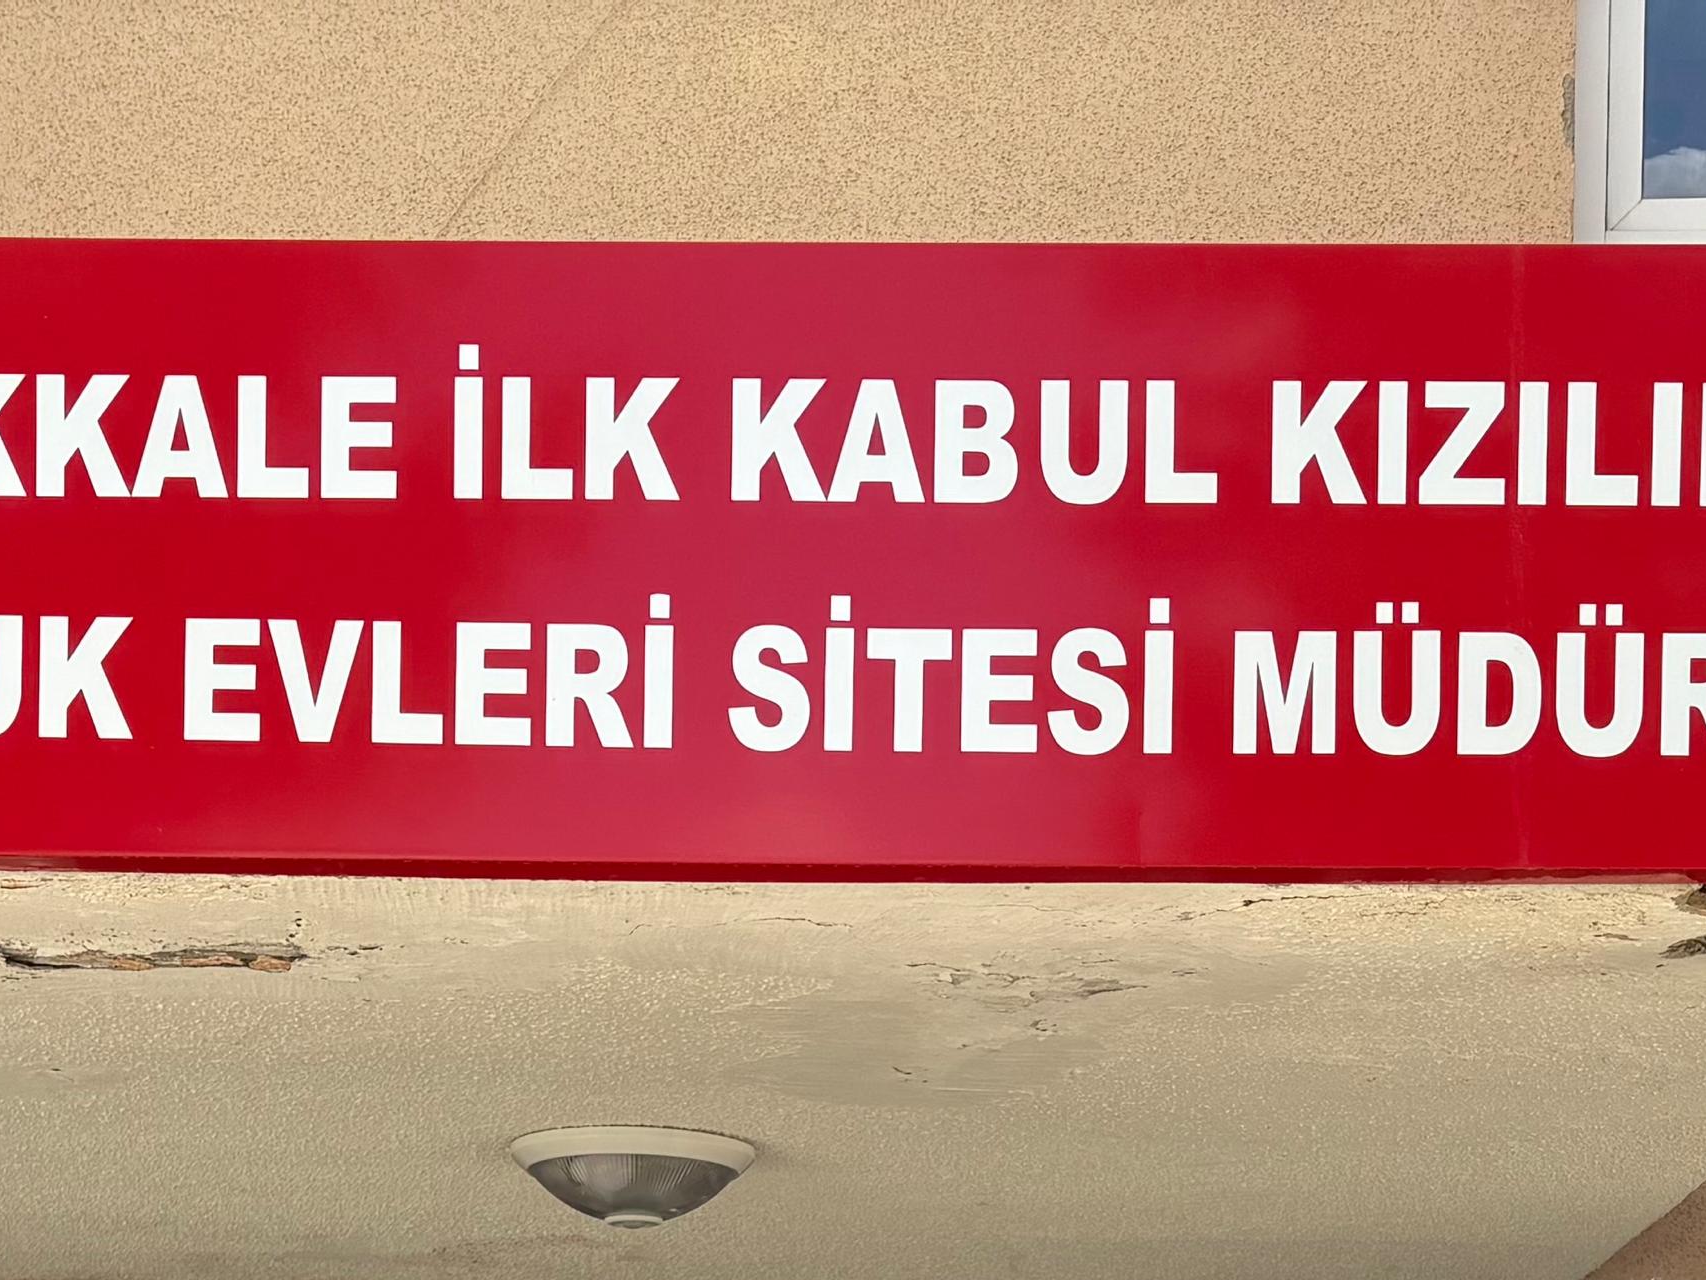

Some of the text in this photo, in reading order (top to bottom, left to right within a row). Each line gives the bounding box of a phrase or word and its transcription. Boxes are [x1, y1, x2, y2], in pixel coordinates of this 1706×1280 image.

[453, 343, 679, 501] İLK
[730, 377, 1217, 504] KABUL
[183, 593, 673, 748] EVLERİ
[728, 595, 1173, 756] SİTESİ
